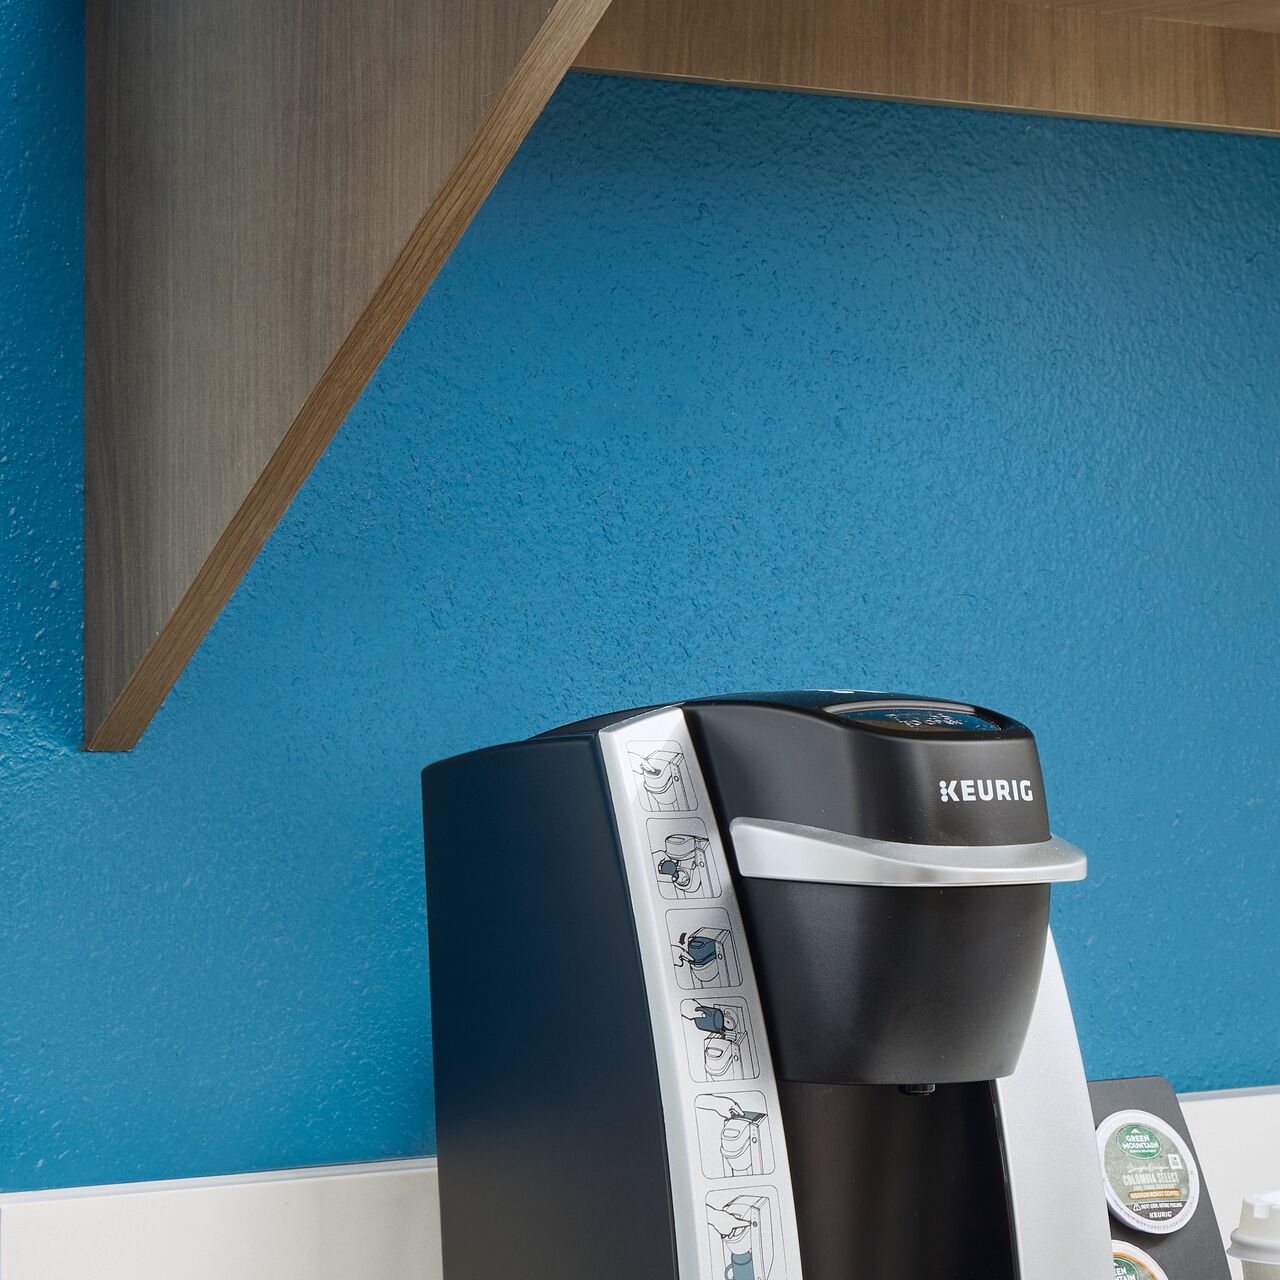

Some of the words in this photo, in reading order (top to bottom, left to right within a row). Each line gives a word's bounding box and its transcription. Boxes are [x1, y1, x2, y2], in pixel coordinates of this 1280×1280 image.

[939, 779, 1034, 802] KEURIG
[1125, 1134, 1150, 1142] GREEN
[1122, 1141, 1160, 1150] MOUNTAIN
[1122, 1173, 1157, 1186] COLOMBIA
[1157, 1172, 1179, 1183] SELECT
[1149, 1211, 1173, 1219] KEURIG
